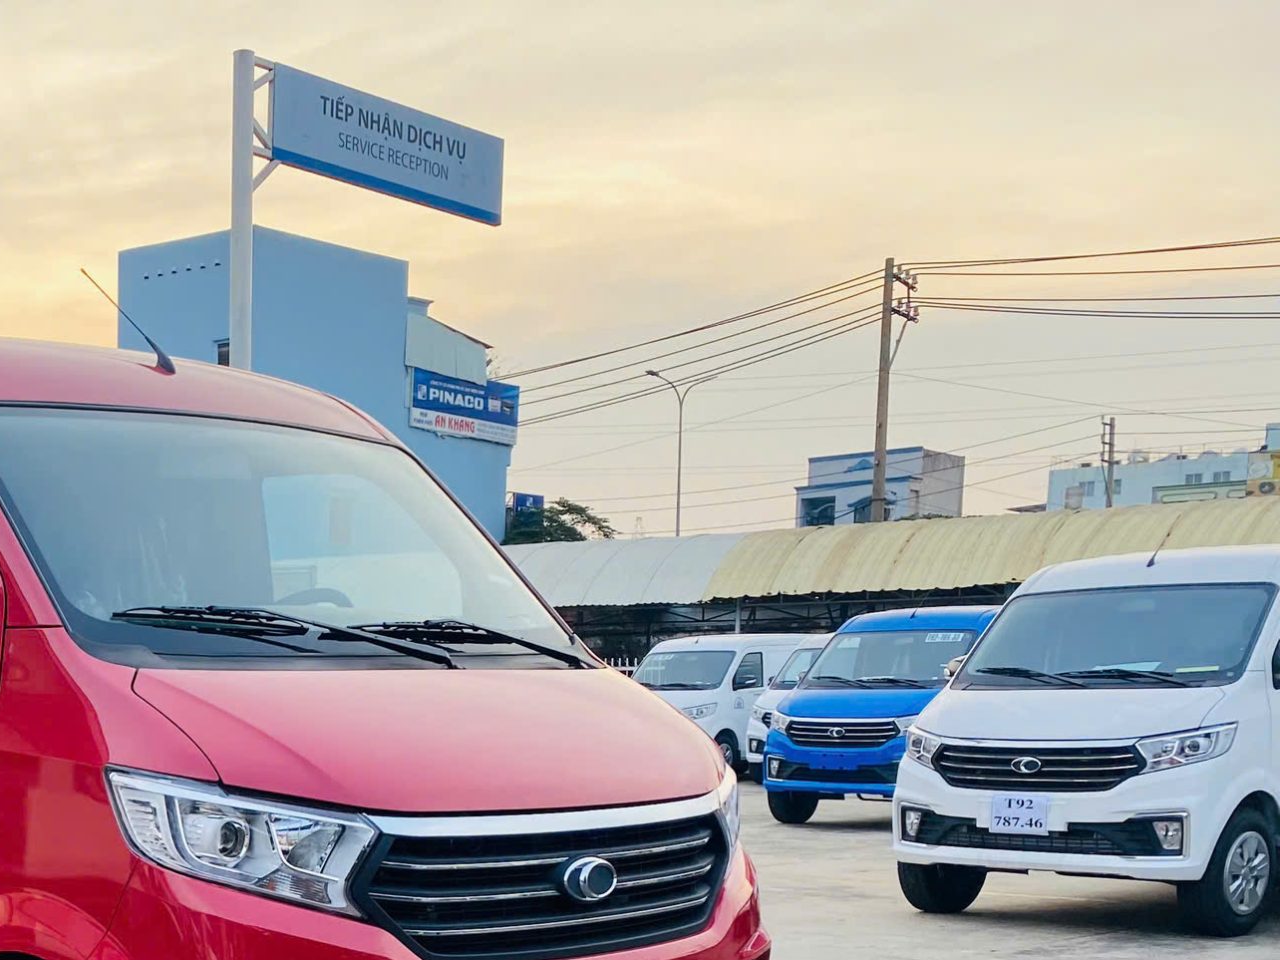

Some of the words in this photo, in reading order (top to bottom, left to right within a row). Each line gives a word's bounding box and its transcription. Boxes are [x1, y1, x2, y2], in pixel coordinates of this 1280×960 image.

[320, 95, 354, 122] TIẾP
[358, 108, 403, 141] NHẬN
[407, 124, 443, 153] DỊCH
[447, 137, 467, 165] VỤ
[338, 132, 385, 162] SERVICE
[388, 147, 449, 181] RECEPTION
[429, 387, 484, 411] PINACO
[434, 415, 447, 428] AN
[448, 417, 476, 433] KHANG
[1004, 797, 1034, 809] T92
[994, 816, 1043, 828] 787.46
